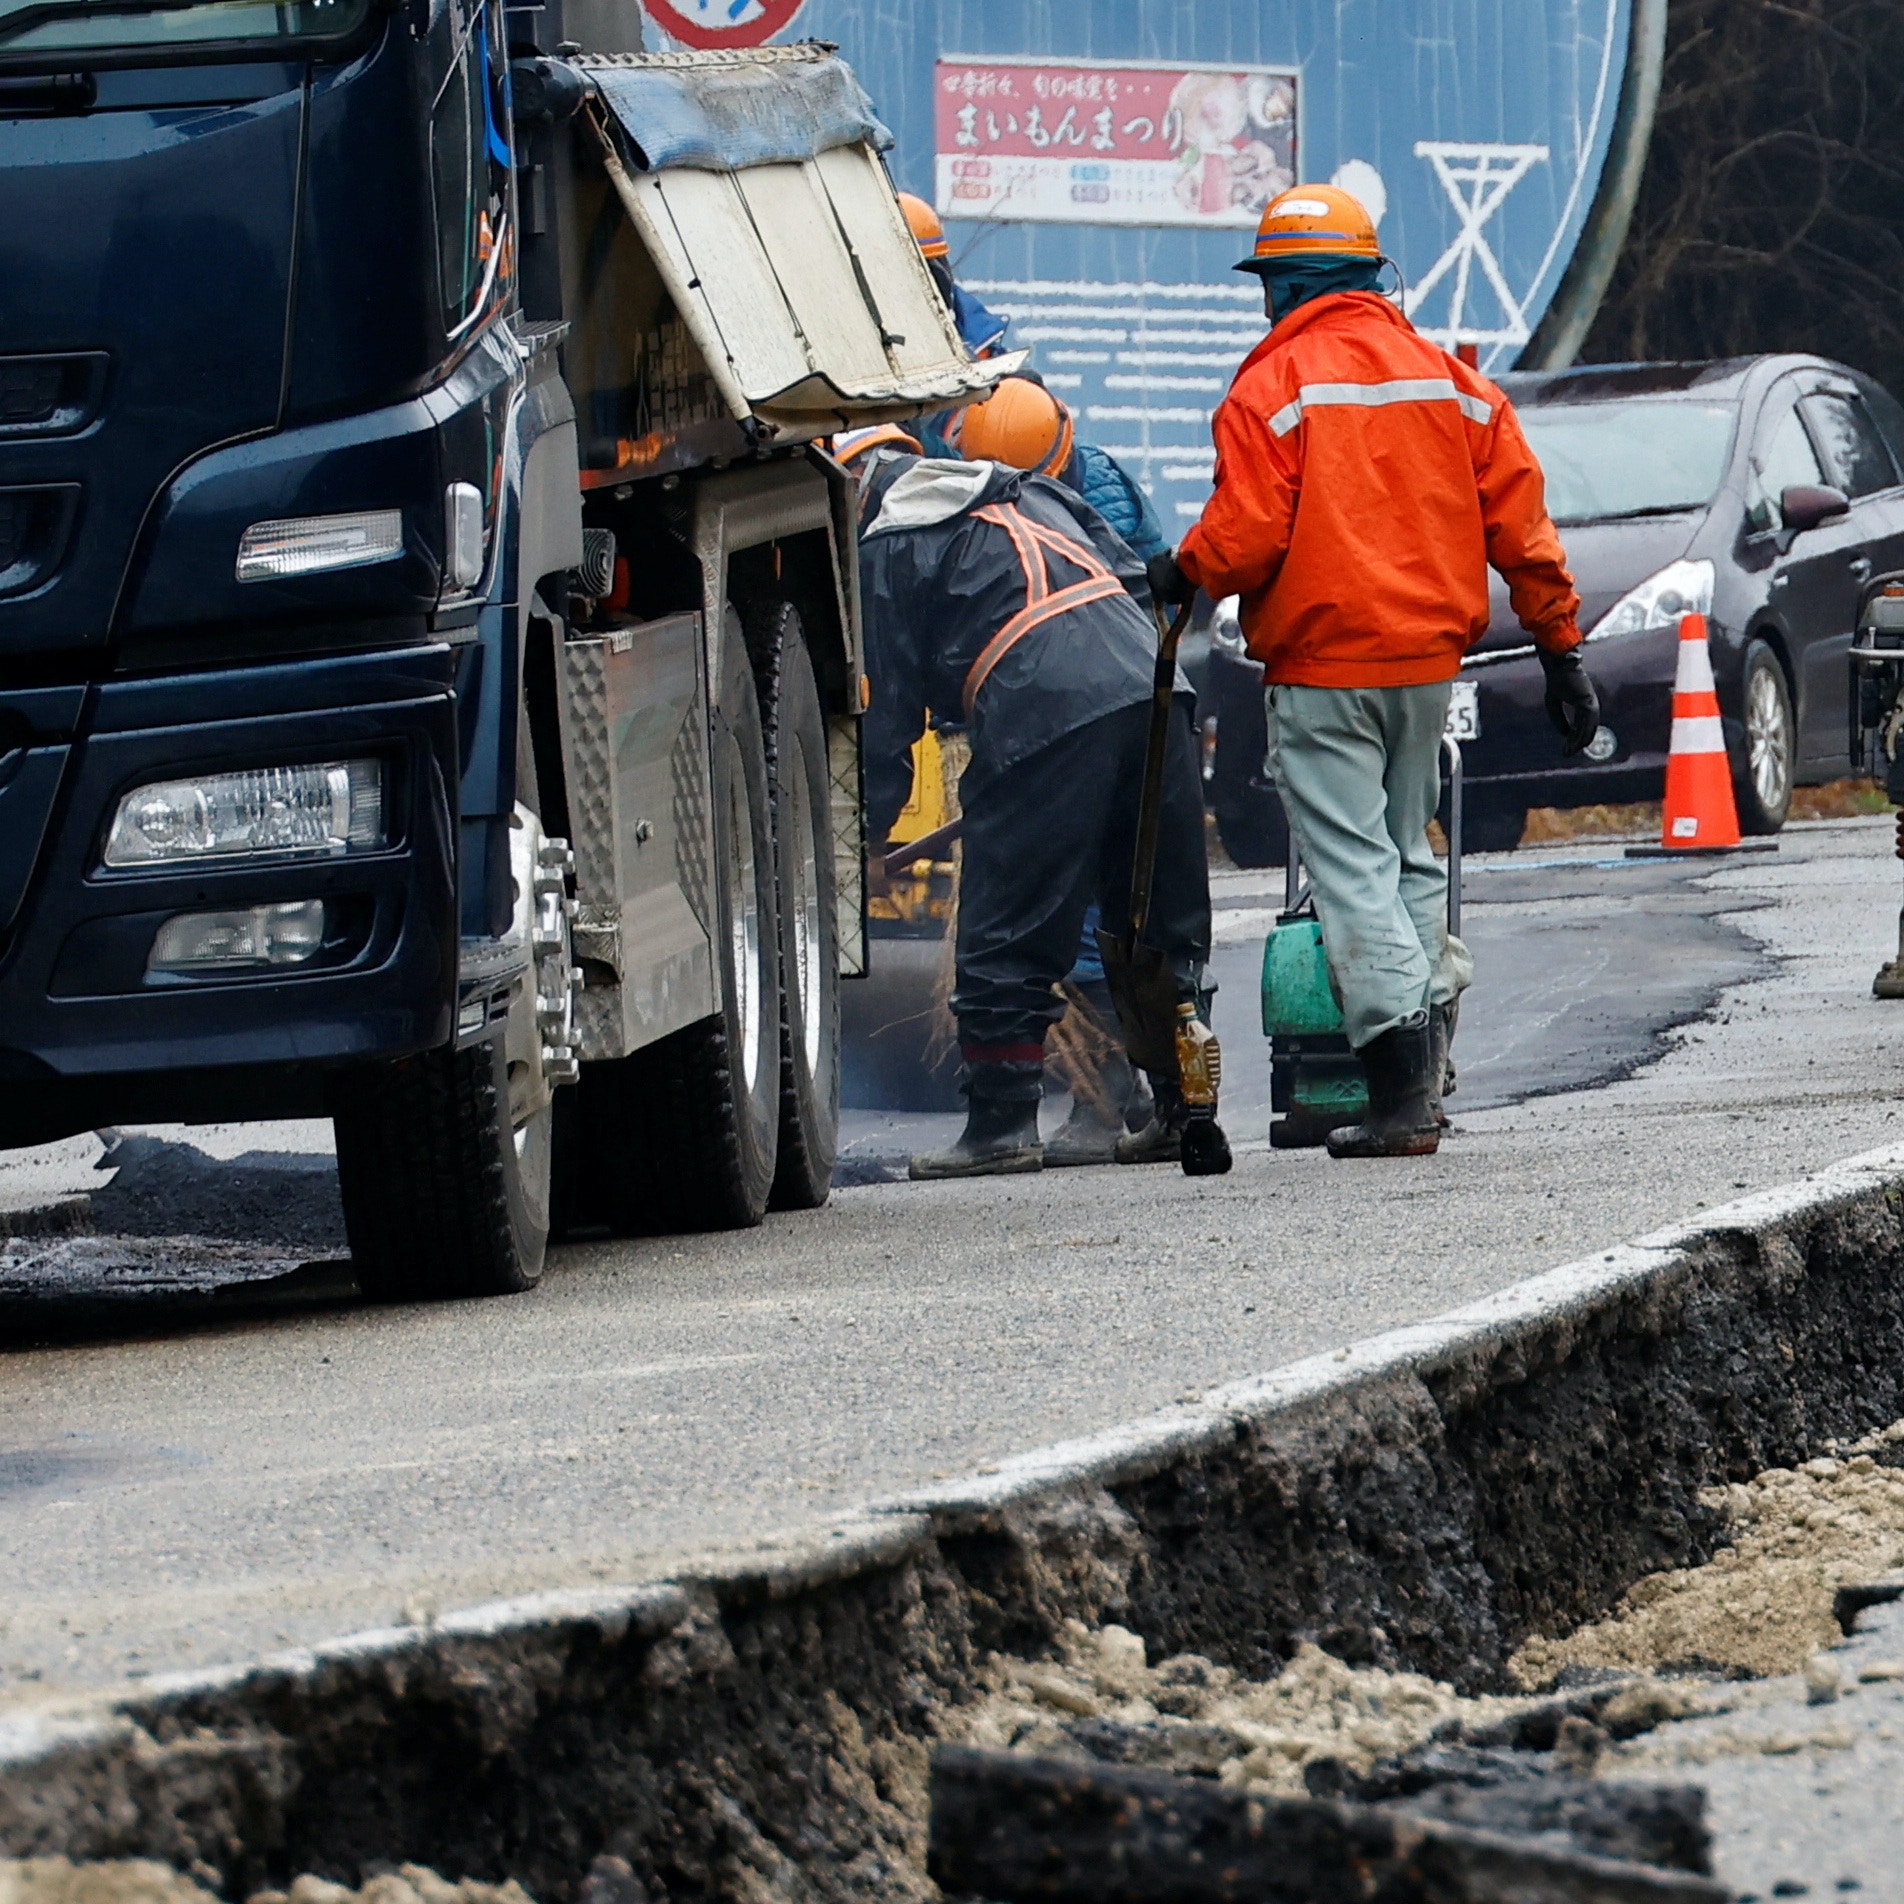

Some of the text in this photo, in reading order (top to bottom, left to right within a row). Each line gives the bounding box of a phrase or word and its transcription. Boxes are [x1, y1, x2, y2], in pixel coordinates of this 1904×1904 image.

[954, 101, 1185, 152] まいもんまつり
